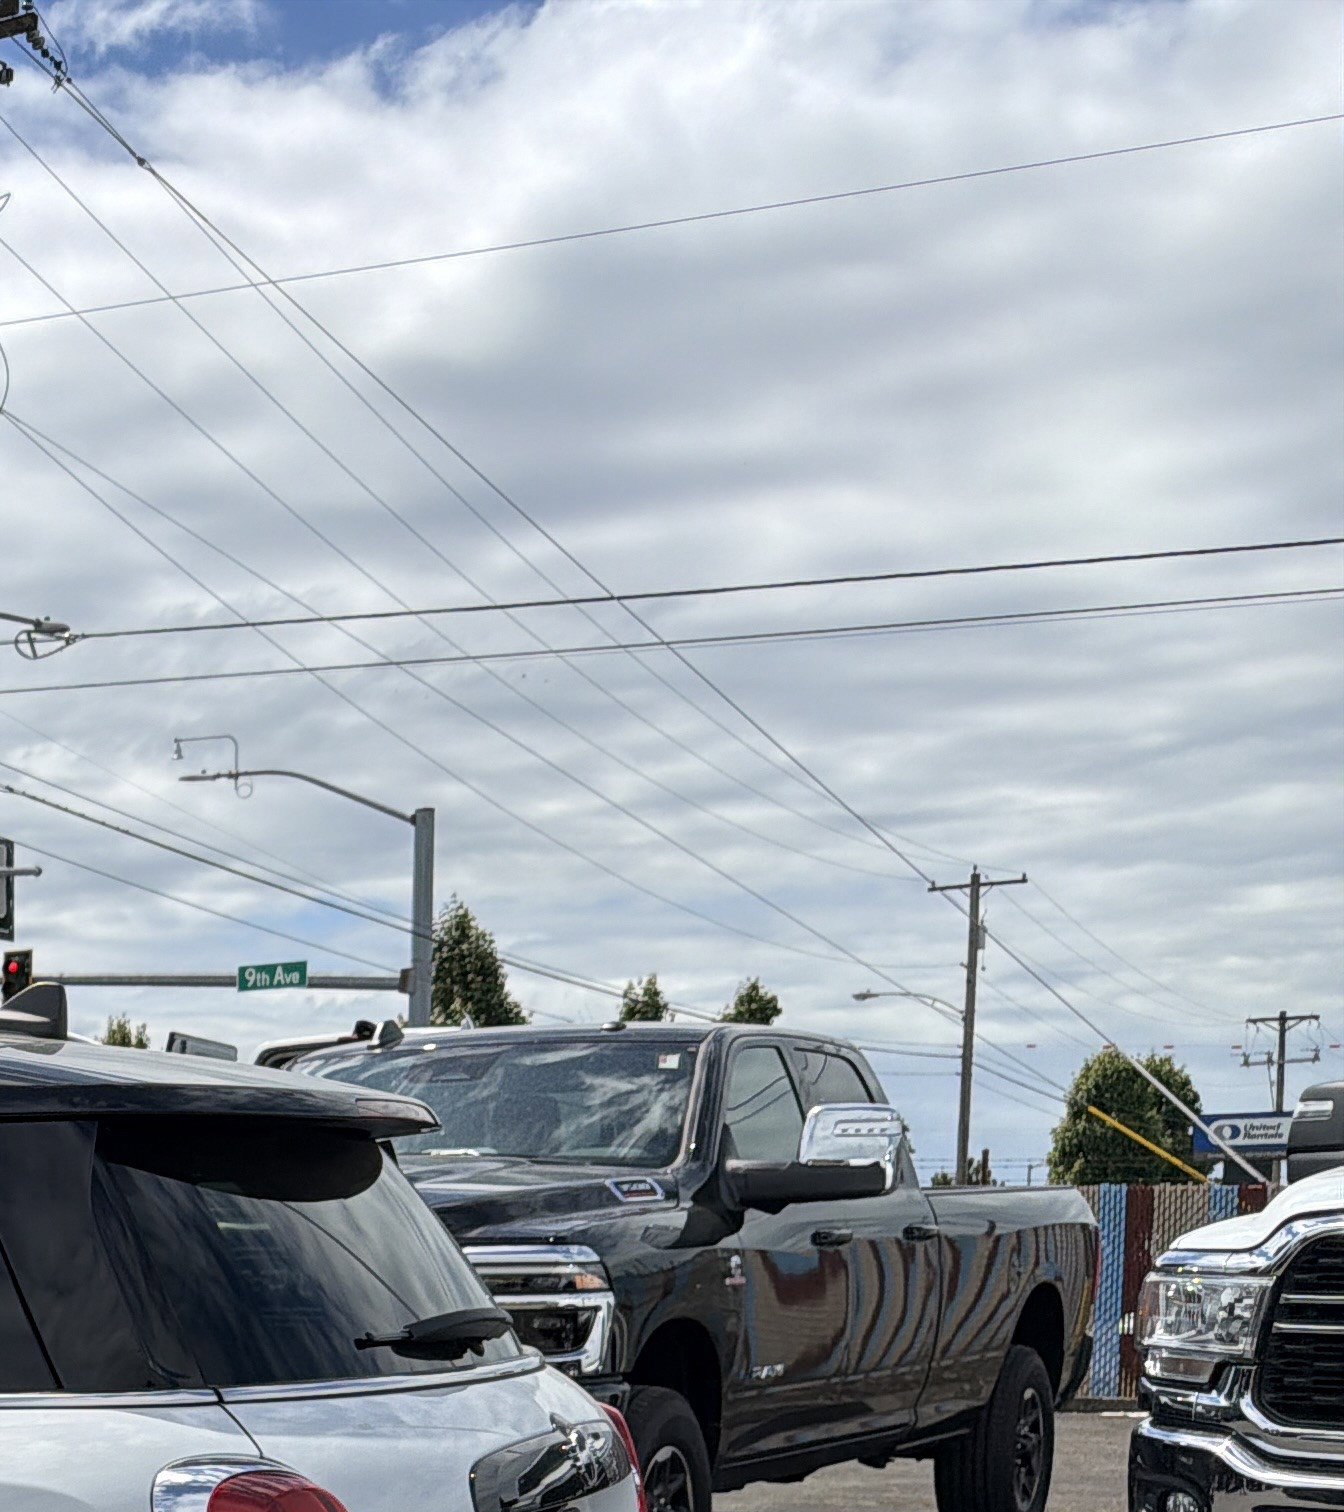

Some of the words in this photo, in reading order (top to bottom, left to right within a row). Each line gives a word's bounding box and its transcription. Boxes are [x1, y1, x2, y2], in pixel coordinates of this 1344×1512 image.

[244, 967, 270, 988] 9th
[273, 965, 300, 986] Ave
[1243, 1122, 1281, 1132] United
[1242, 1131, 1284, 1140] Rentals
